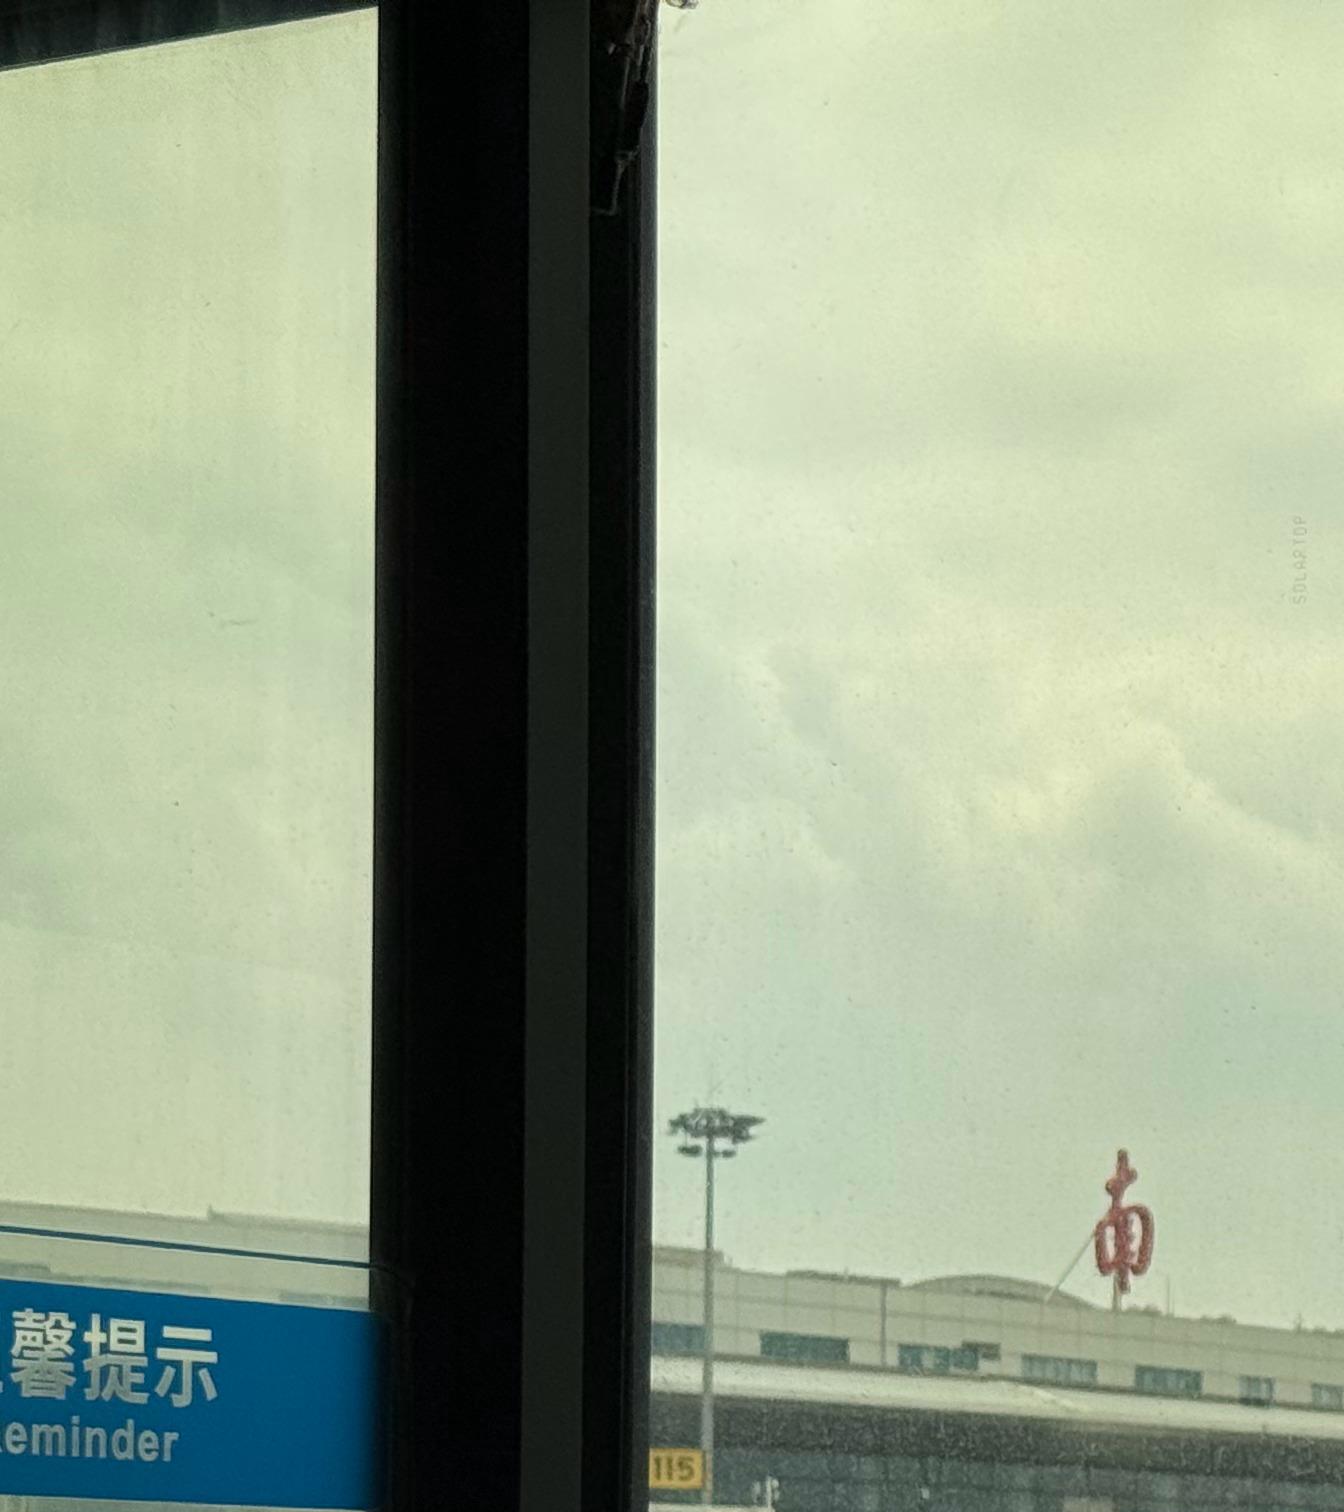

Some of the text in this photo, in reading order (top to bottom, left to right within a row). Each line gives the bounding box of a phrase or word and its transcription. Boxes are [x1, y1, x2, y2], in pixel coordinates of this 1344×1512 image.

[0, 1308, 219, 1408] 馨提示
[0, 1415, 180, 1462] eminder
[652, 1455, 695, 1482] 115
